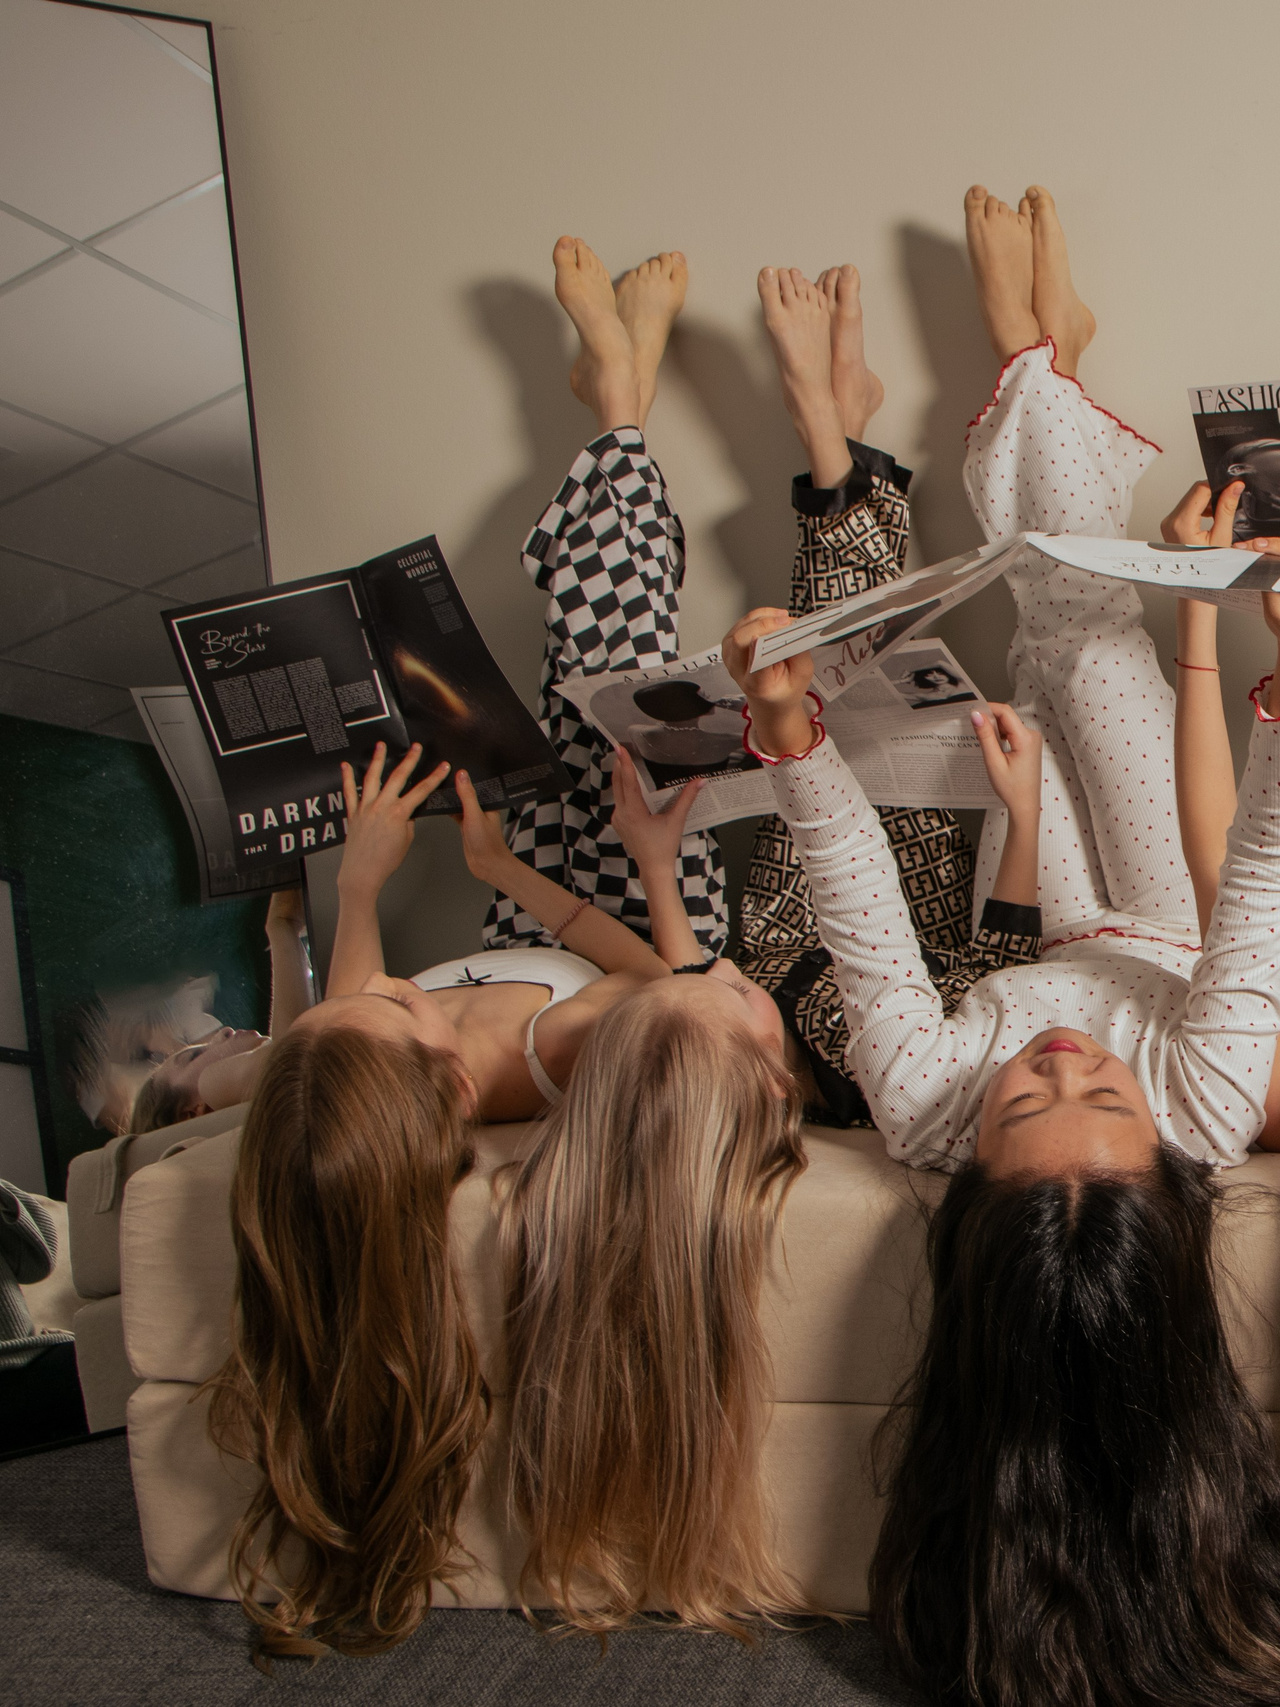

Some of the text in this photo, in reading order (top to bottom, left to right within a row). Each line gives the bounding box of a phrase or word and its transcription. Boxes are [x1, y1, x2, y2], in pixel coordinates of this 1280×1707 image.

[397, 549, 433, 569] CELESTIAL
[405, 560, 438, 579] WONDERS
[200, 623, 271, 655] Beyond the
[225, 640, 266, 668] Stars
[623, 653, 722, 684] ALLUR
[664, 772, 712, 787] NAVIGATING
[239, 790, 346, 834] DARKN
[244, 817, 348, 856] THAT DRA
